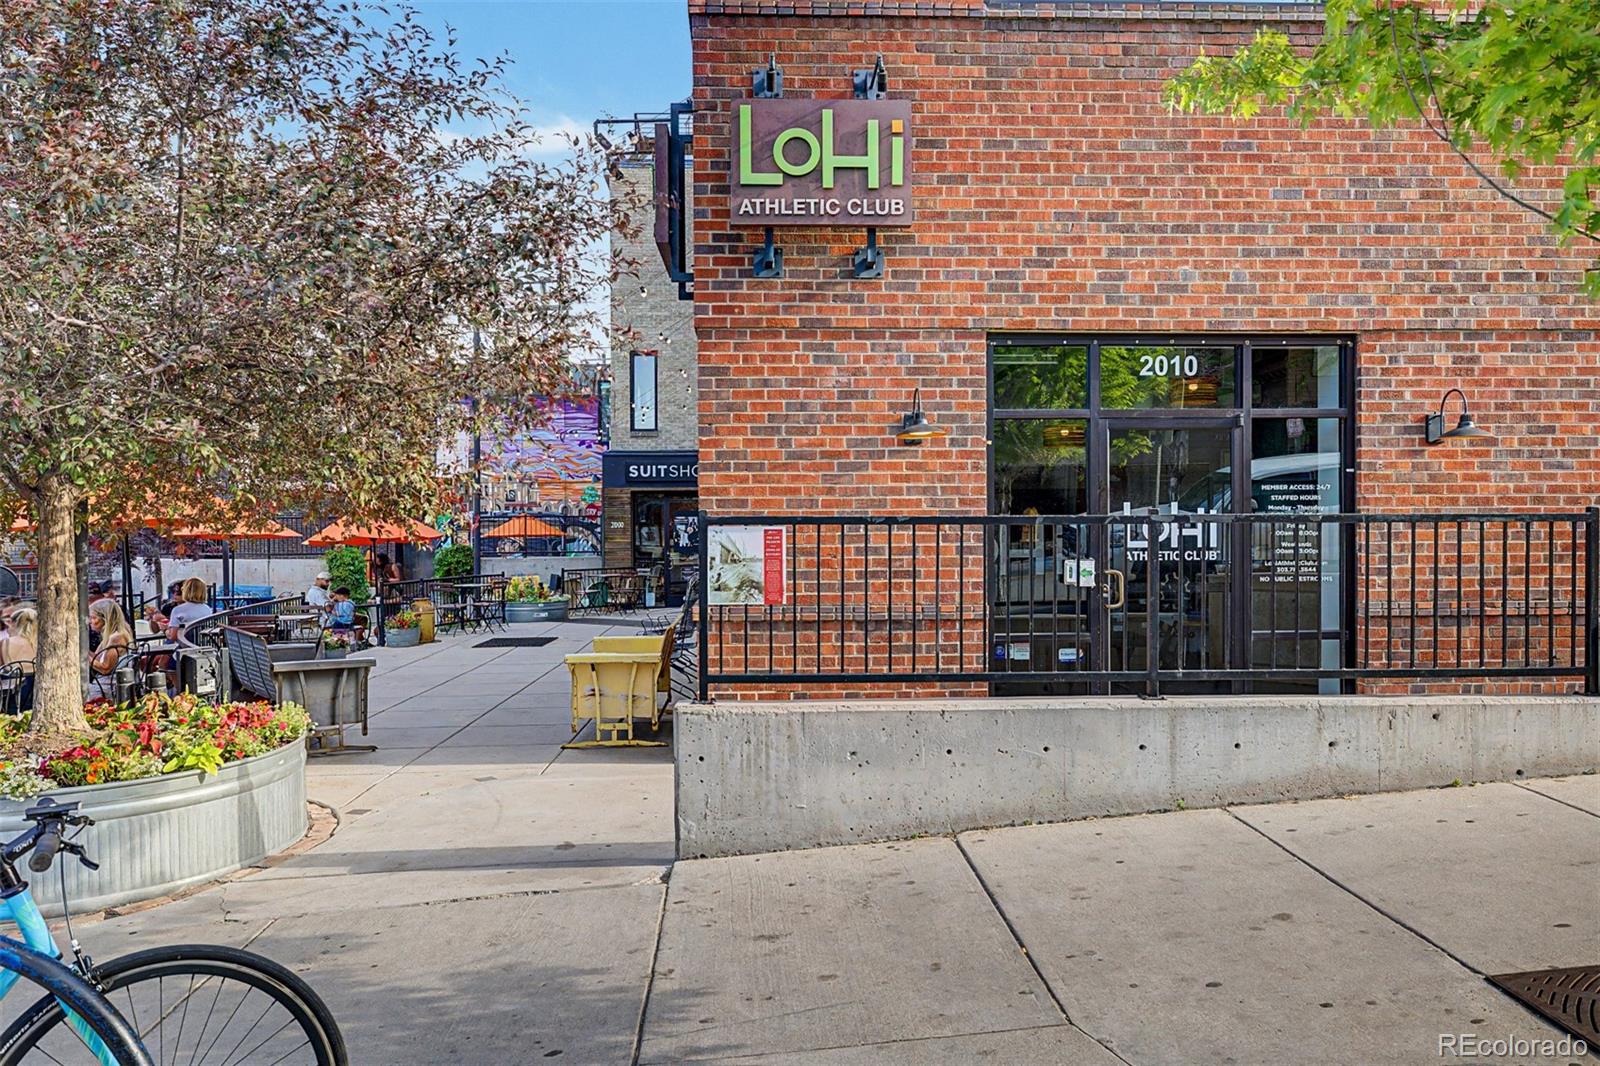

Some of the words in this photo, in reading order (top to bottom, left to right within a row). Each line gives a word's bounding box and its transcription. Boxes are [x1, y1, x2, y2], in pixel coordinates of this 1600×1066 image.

[738, 199, 841, 216] ATHLETIC
[847, 199, 904, 216] CLUB
[1139, 355, 1198, 377] 2010
[1126, 551, 1180, 561] ATHETIC
